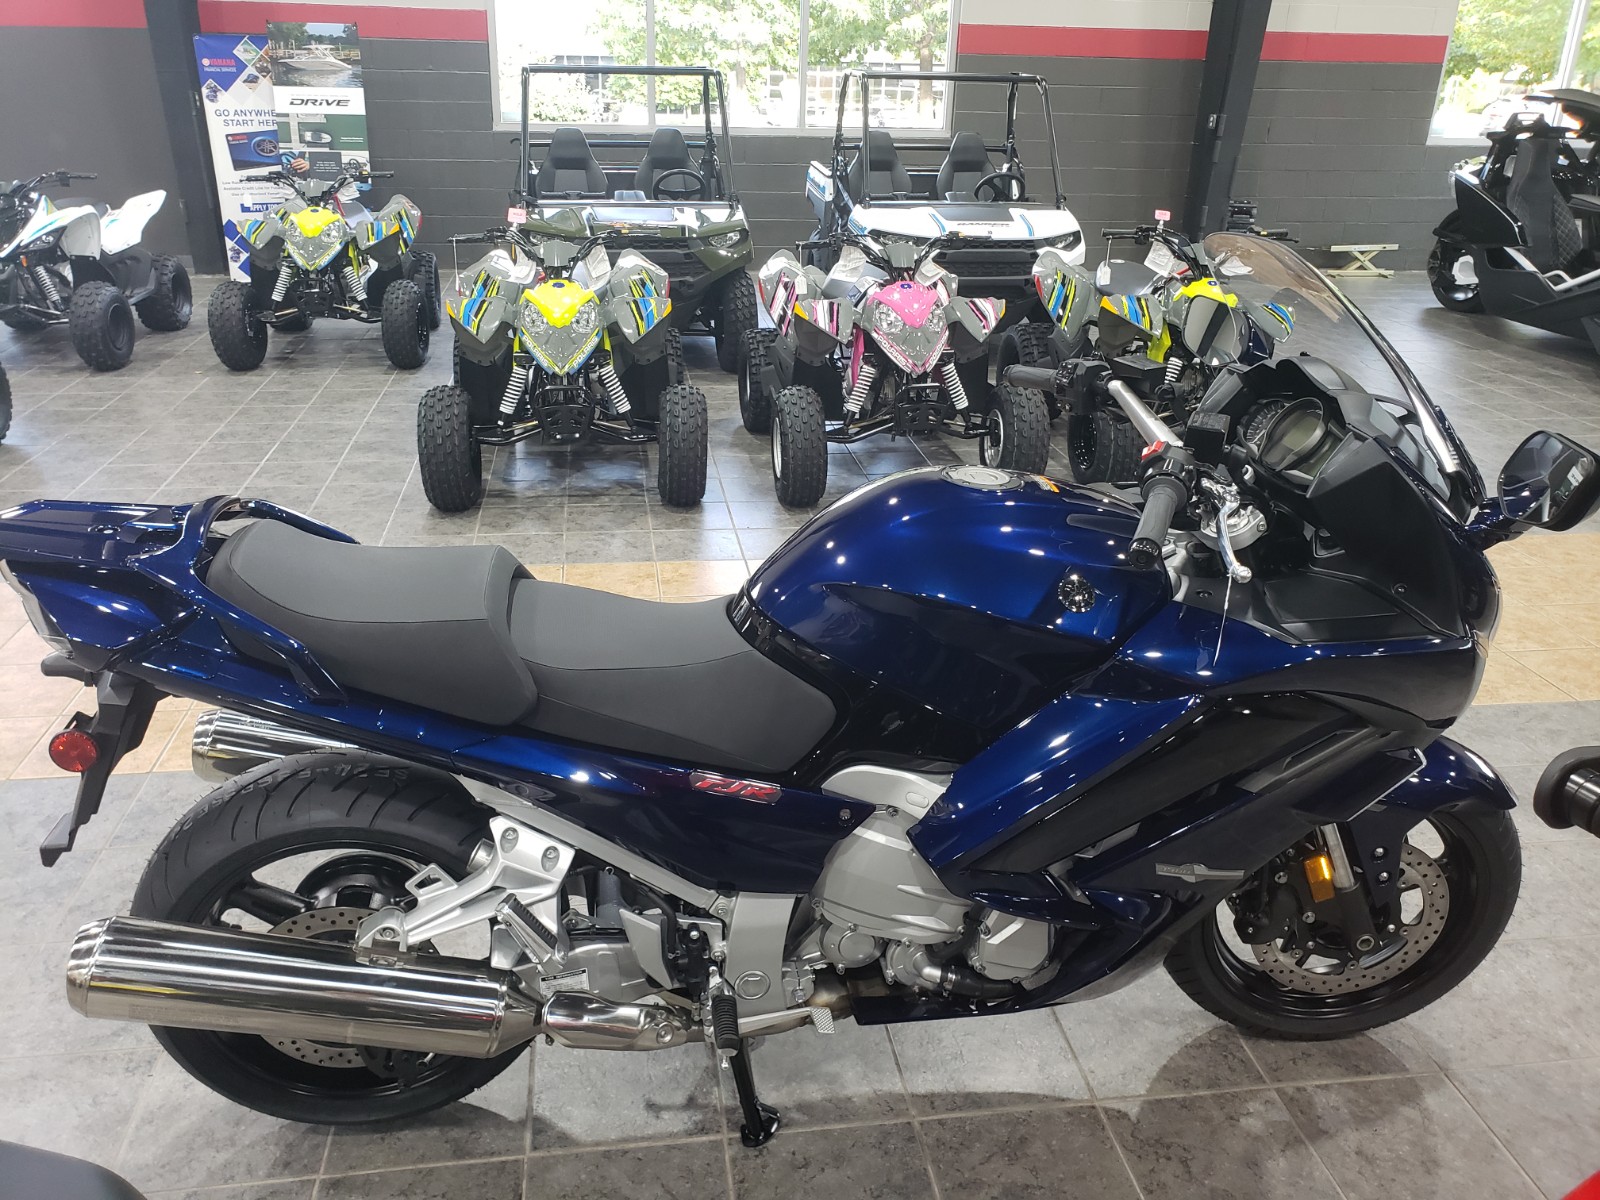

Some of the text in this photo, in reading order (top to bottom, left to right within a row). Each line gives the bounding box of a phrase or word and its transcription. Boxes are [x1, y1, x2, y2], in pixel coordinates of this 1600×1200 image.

[210, 58, 236, 66] YAMAHA
[214, 109, 230, 117] GO
[223, 119, 254, 127] START
[523, 334, 549, 366] POLARIS
[572, 337, 598, 367] POLARIS
[877, 335, 907, 366] POLARIS
[694, 778, 777, 799] FJR
